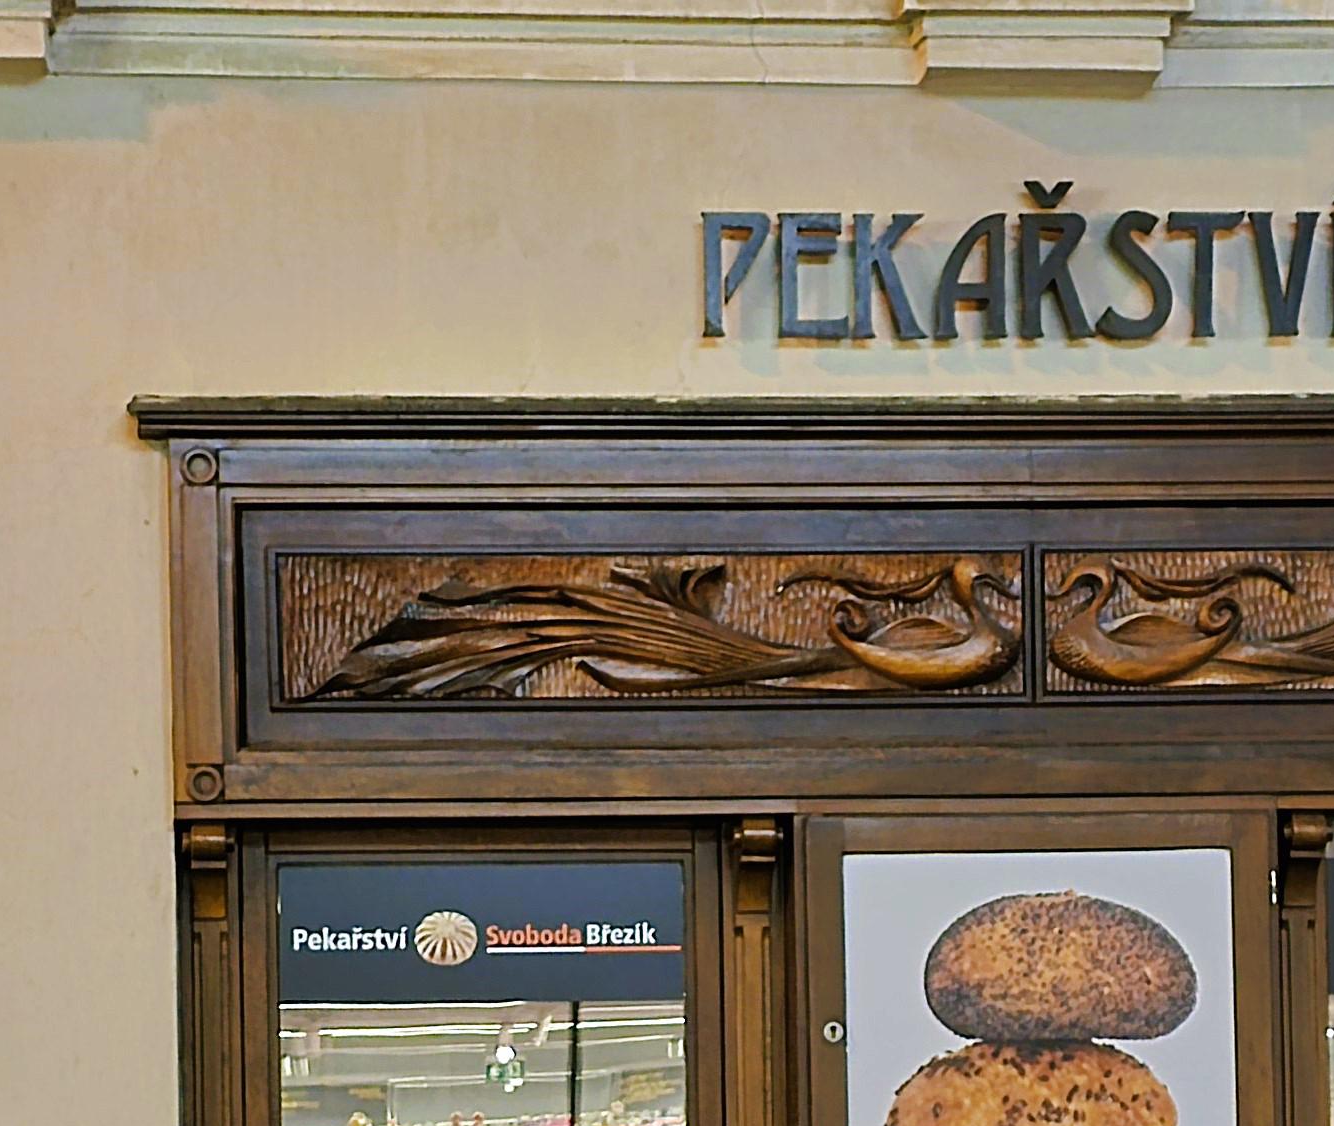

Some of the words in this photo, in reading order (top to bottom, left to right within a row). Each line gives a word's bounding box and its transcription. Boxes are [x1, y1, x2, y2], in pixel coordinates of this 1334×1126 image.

[292, 925, 408, 952] Pekařství
[485, 923, 582, 946] Svoboda
[586, 922, 657, 946] Březík
